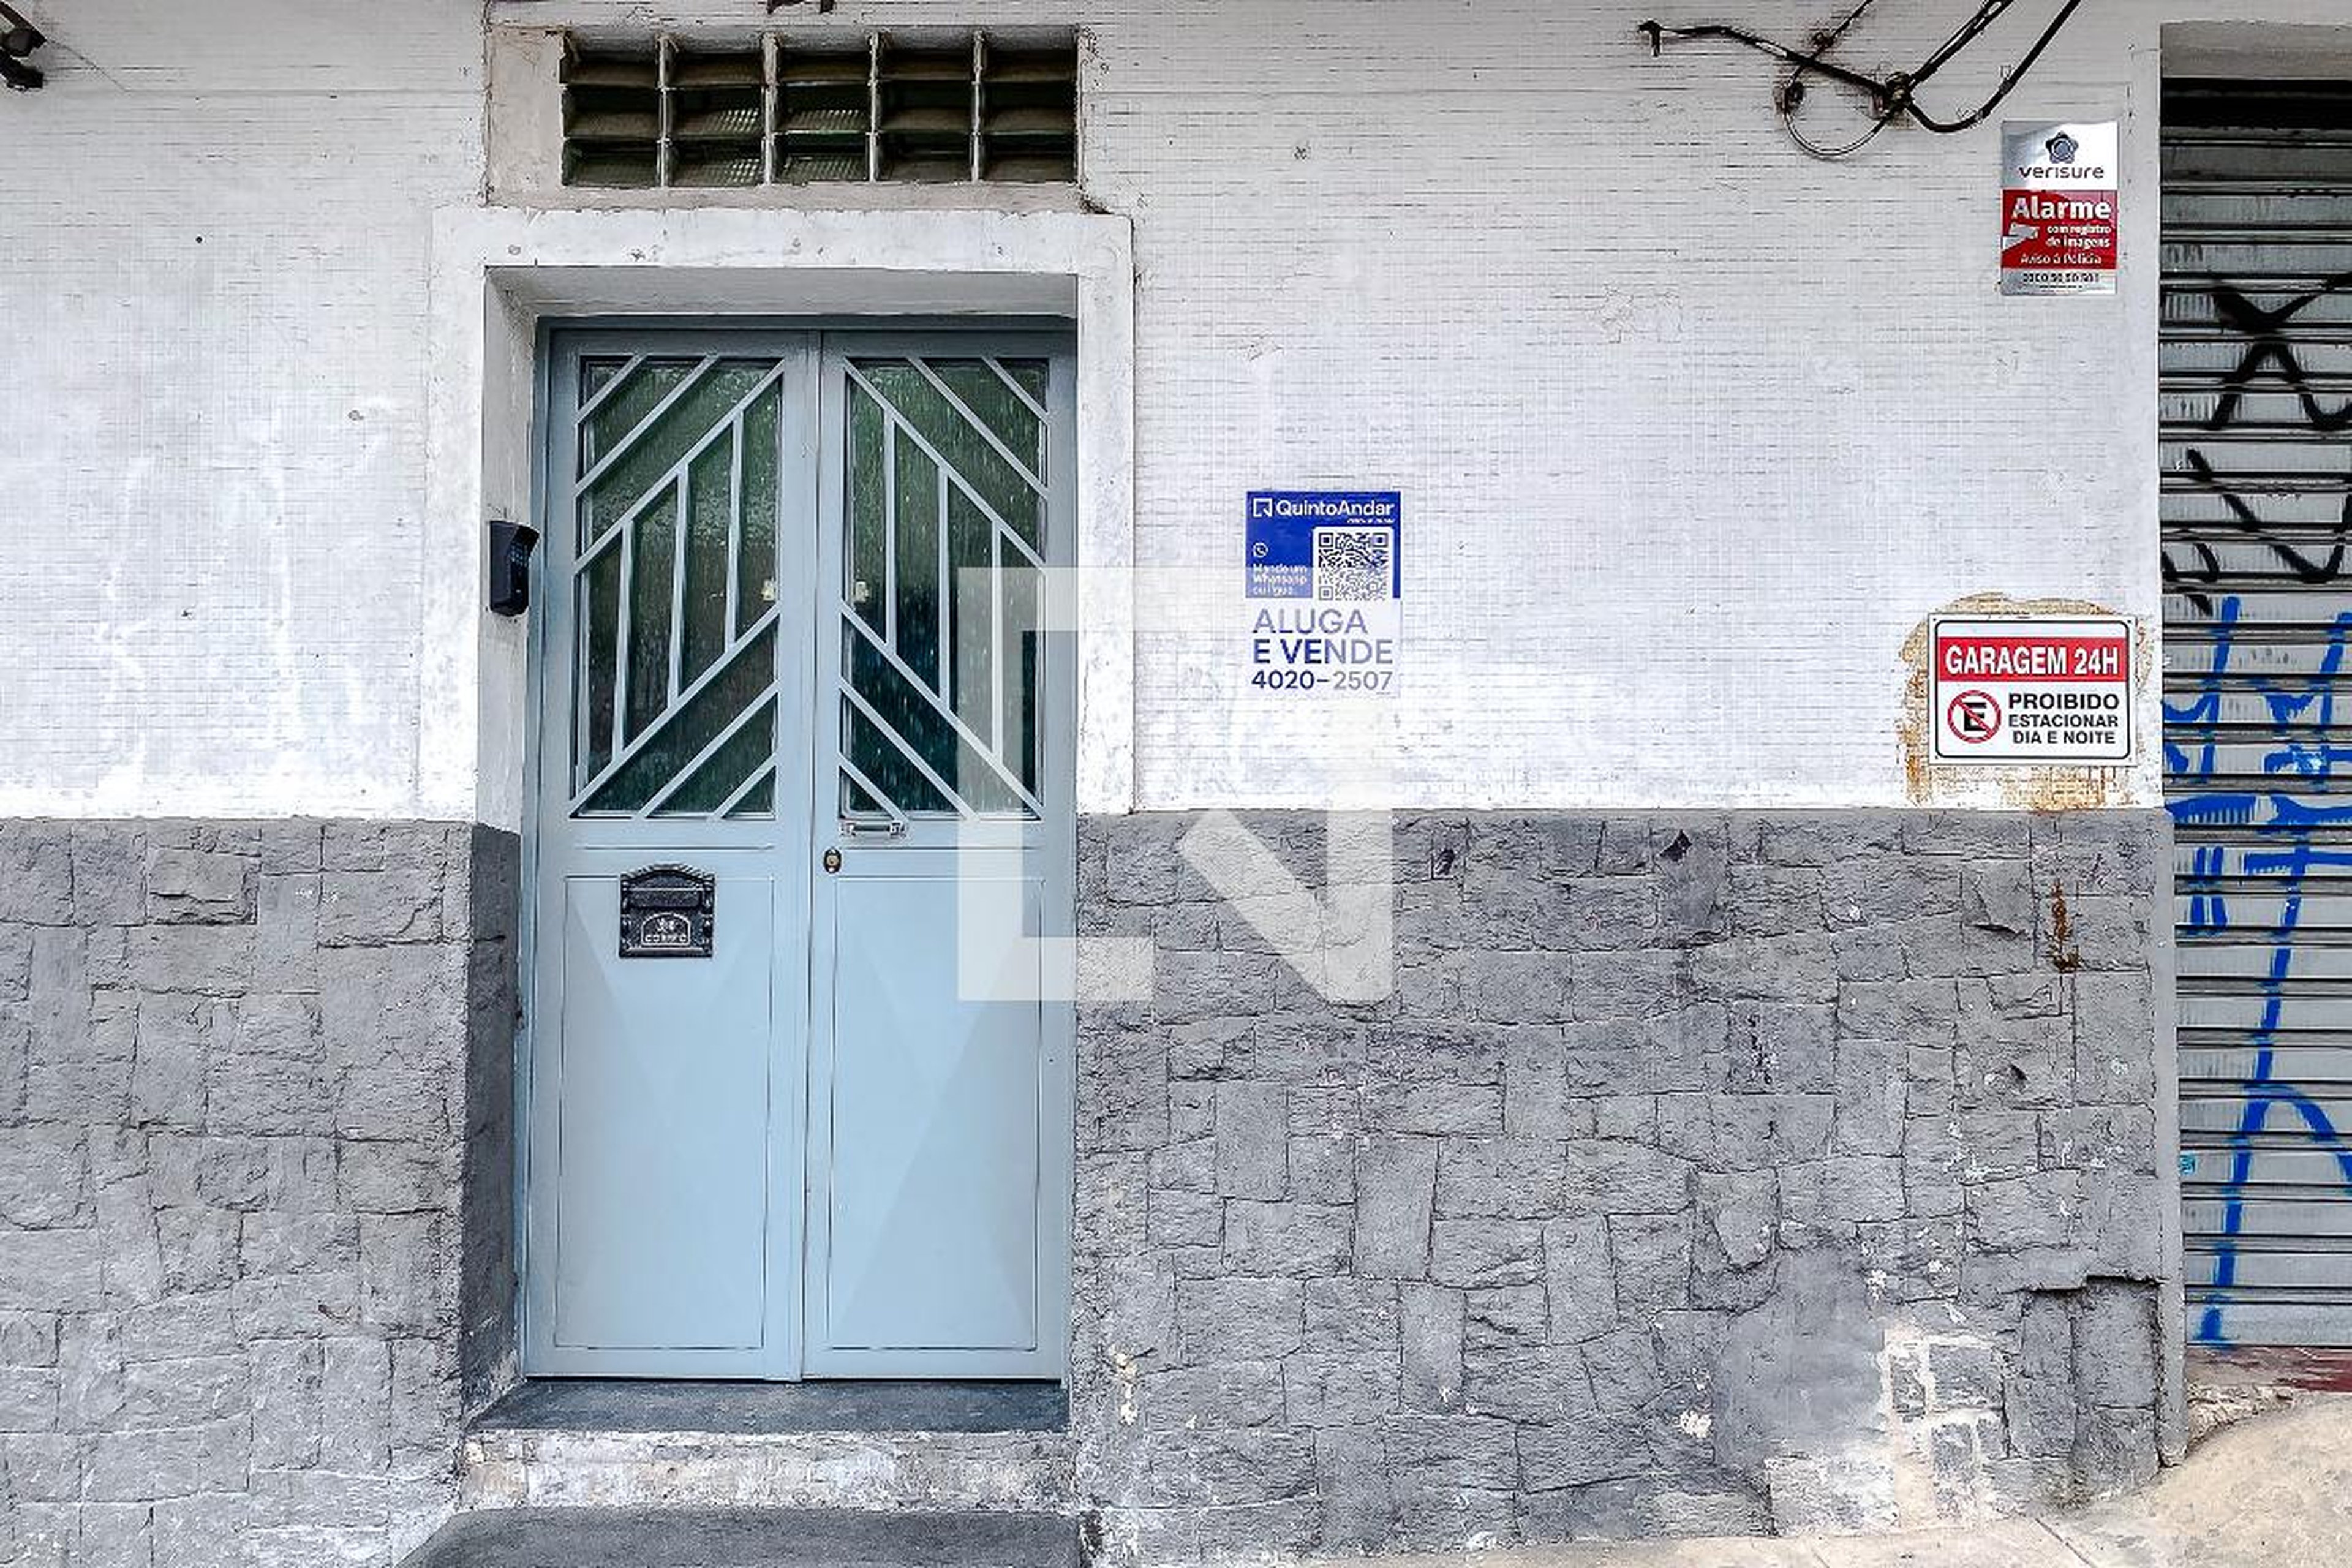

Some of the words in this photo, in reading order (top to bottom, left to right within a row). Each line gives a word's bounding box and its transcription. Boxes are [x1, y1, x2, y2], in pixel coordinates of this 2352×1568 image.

[2019, 167, 2104, 178] verisure
[2011, 196, 2111, 219] Alarme
[1276, 500, 1395, 516] QuintoAndar
[1253, 608, 1368, 634] ALUGA
[1253, 639, 1270, 664] E
[1280, 639, 1393, 664] VENDE
[1945, 646, 2067, 674] GARAGEM
[2073, 647, 2118, 674] 24H
[1251, 670, 1393, 690] 4020-2507
[2009, 693, 2119, 709] PROIBIDO
[2008, 714, 2118, 728] ESTACIONAR
[2013, 731, 2042, 744] DIA
[2047, 731, 2058, 744] E
[2064, 731, 2116, 744] NOITE
